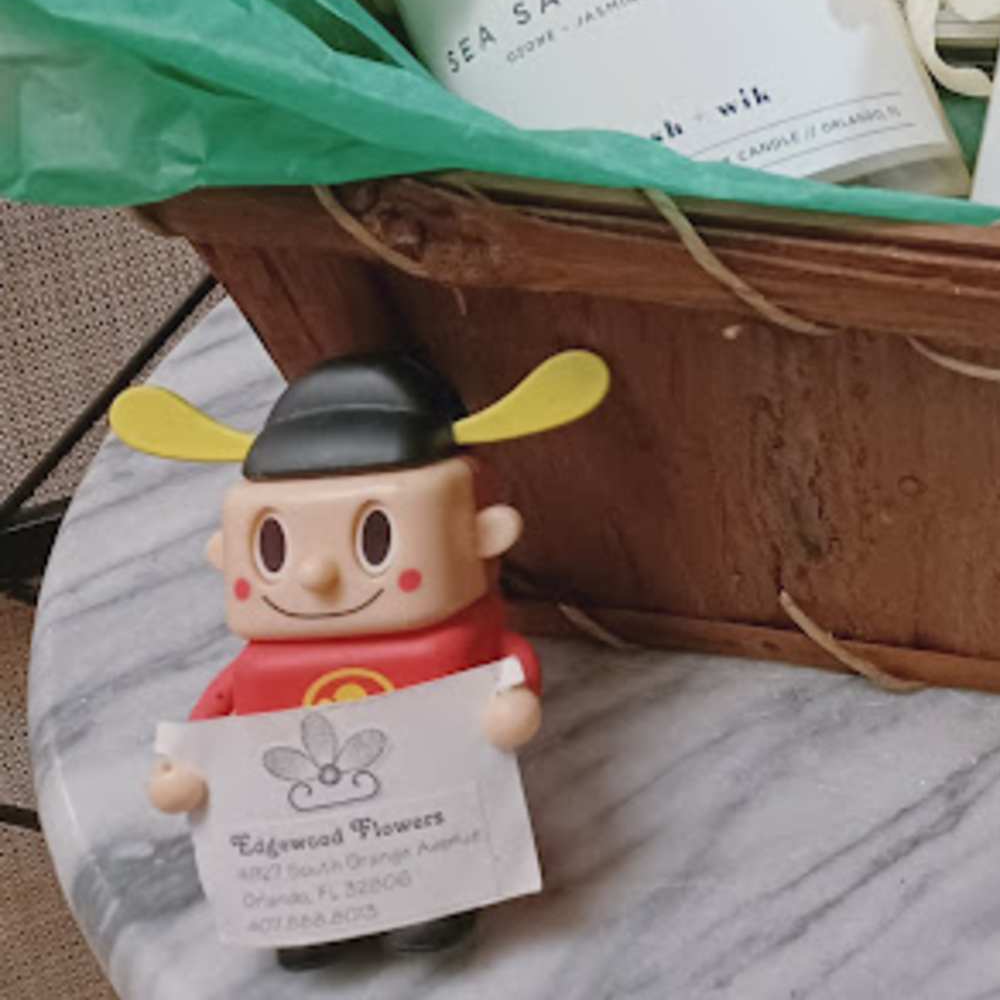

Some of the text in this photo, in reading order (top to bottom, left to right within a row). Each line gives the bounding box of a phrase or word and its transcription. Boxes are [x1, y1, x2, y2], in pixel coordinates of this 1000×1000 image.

[446, 23, 497, 74] SEA
[738, 130, 801, 162] CANDLE
[229, 810, 445, 859] Edgewood Flowers
